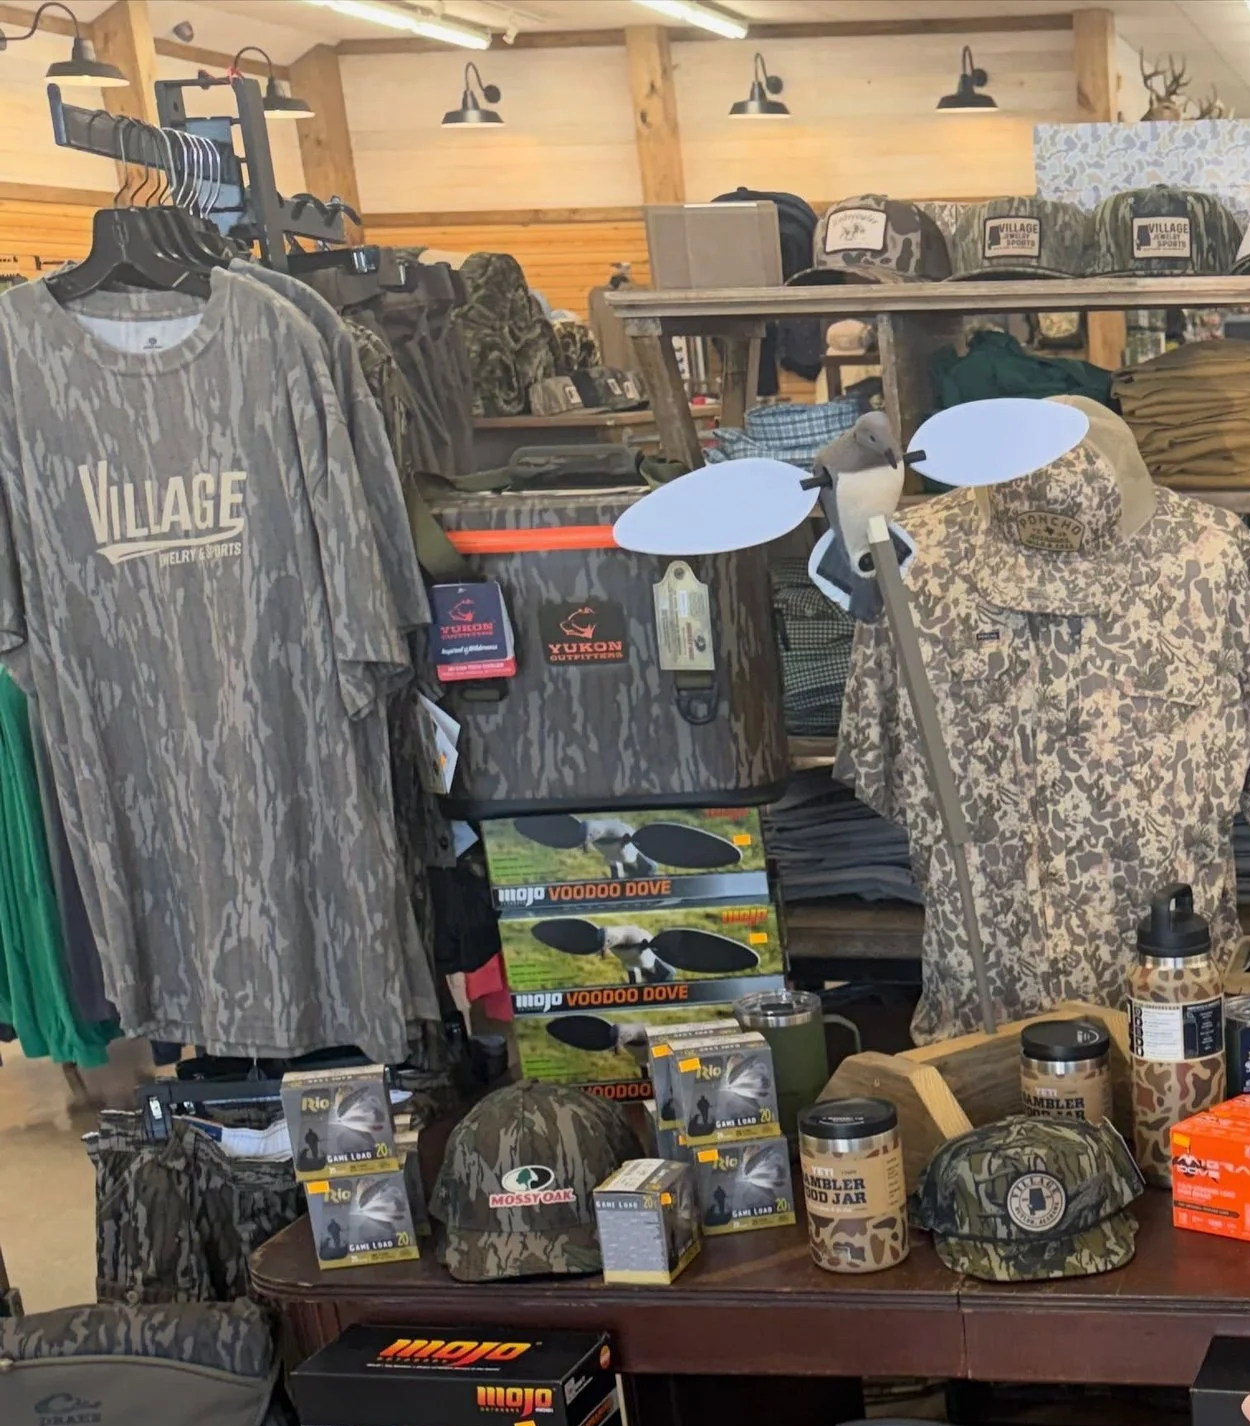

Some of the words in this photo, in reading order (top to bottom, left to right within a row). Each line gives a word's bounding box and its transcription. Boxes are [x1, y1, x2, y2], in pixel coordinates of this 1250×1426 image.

[999, 223, 1039, 234] VILLAGE
[1148, 223, 1188, 234] VILLAGE
[78, 460, 247, 544] VILLAGE
[1019, 514, 1081, 536] PONCHO
[440, 622, 494, 635] YUKON
[548, 640, 623, 654] YUKON
[550, 652, 624, 662] OUTFITTERS
[498, 887, 545, 907] mojo
[549, 882, 621, 901] VOODOO
[625, 879, 672, 896] DOVE
[516, 992, 563, 1013] mojo
[566, 988, 639, 1007] VOODOO
[643, 985, 688, 1001] DOVE
[696, 1063, 722, 1080] Rio
[301, 1096, 330, 1113] Rio
[715, 1118, 735, 1128] GAME
[737, 1116, 757, 1126] LOAD
[759, 1108, 771, 1122] 20
[327, 1154, 349, 1163] GAME
[351, 1152, 372, 1161] LOAD
[374, 1142, 389, 1157] 20
[712, 1154, 738, 1171] Rio
[811, 1165, 834, 1178] YETI
[803, 1176, 866, 1191] AMBLER
[323, 1187, 351, 1204] Rio
[490, 1193, 540, 1206] MOSSY
[542, 1190, 573, 1203] OAK
[805, 1190, 828, 1205] OOD
[832, 1190, 867, 1205] JAR
[732, 1209, 751, 1219] GAME
[753, 1206, 773, 1215] LOAD
[776, 1197, 787, 1212] 20
[349, 1243, 370, 1252] GAME
[372, 1240, 394, 1249] LOAD
[395, 1232, 409, 1246] 20
[379, 1338, 532, 1368] mojo
[476, 1386, 552, 1417] mojo
